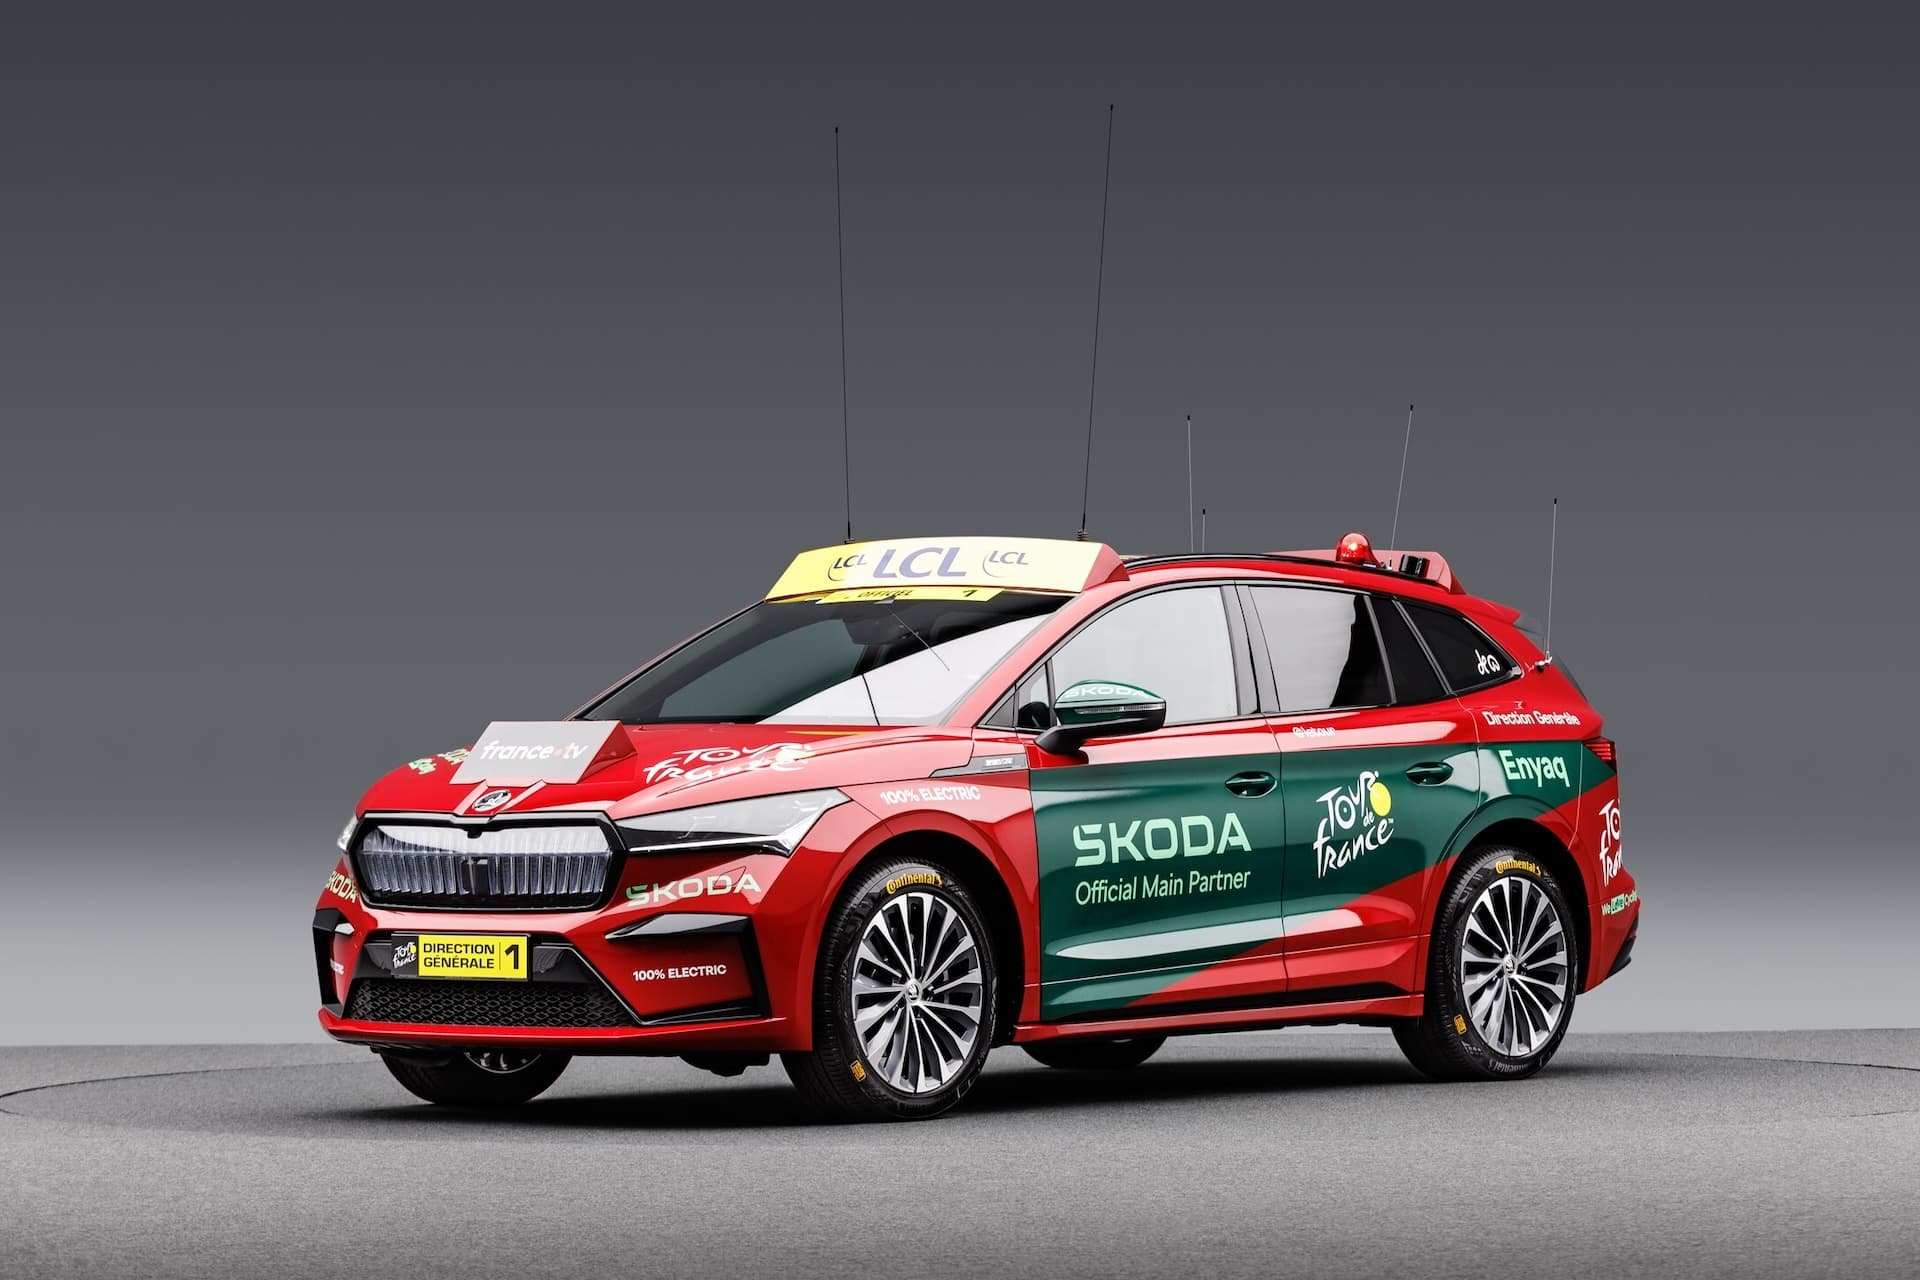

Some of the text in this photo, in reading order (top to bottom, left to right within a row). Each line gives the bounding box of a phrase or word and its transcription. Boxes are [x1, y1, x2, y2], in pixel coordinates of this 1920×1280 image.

[832, 546, 1030, 578] LCL LCL LCL
[1481, 710, 1535, 726] Direction
[1498, 749, 1570, 787] Enyaq
[880, 785, 981, 805] 100% ELECTRIC
[1363, 807, 1375, 828] de
[1495, 858, 1535, 874] Continental
[886, 872, 936, 895] Continental
[1075, 869, 1251, 906] Official Main Partner
[423, 943, 495, 955] DIRECTION
[504, 944, 520, 970] 1
[423, 954, 495, 969] GÉNÉRALE
[632, 964, 728, 982] 100% ELECTRIC
